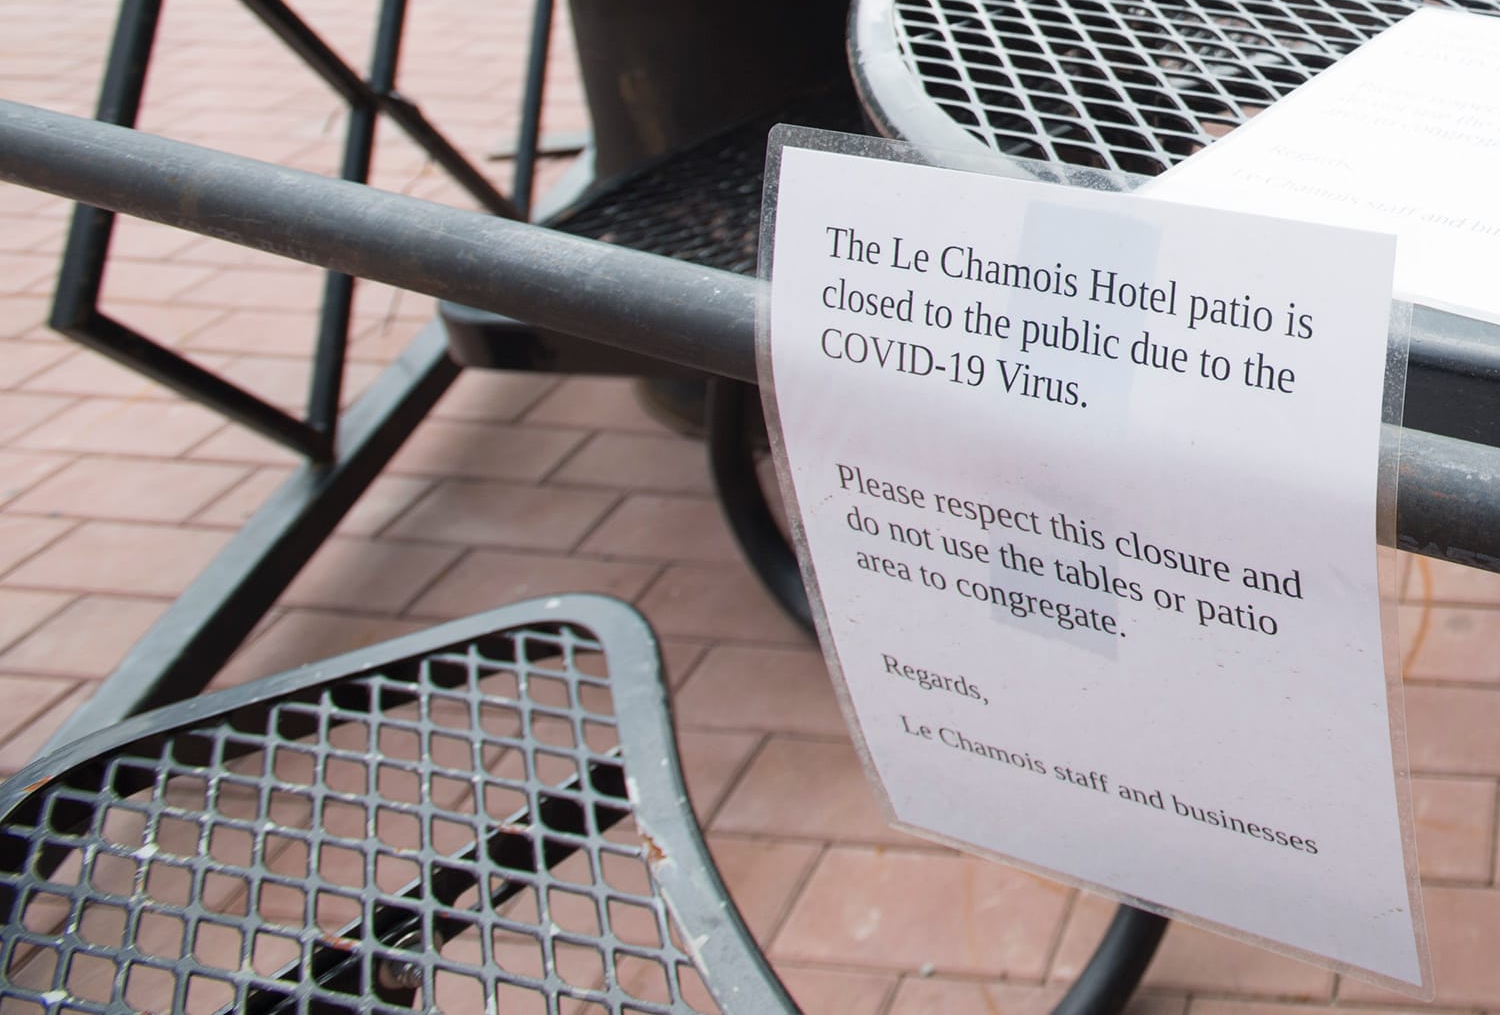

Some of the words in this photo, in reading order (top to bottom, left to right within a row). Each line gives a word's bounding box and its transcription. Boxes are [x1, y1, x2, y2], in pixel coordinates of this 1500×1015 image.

[822, 277, 914, 323] closed
[924, 298, 953, 329] to
[963, 300, 1011, 340] the
[1019, 315, 1120, 360] public
[1130, 330, 1189, 374] due
[1199, 348, 1231, 382] to
[1243, 352, 1296, 394] the
[825, 226, 881, 265] The
[890, 236, 930, 273] Le
[940, 245, 1078, 298] Chamois
[1088, 268, 1177, 316] Hotel
[1186, 294, 1273, 333] patio
[1283, 302, 1313, 340] is
[821, 328, 985, 387] COVID-19
[995, 358, 1088, 409] Virus.
[835, 463, 926, 509] Please
[933, 493, 1043, 536] respect
[1049, 512, 1106, 551] this
[1115, 530, 1231, 583] closure
[1242, 567, 1304, 600] and
[846, 505, 880, 536] do
[887, 522, 935, 551] not
[940, 535, 990, 564] use
[998, 542, 1045, 577] the
[1053, 558, 1144, 602] tables
[1153, 588, 1186, 614] or
[1195, 598, 1278, 636] patio
[856, 551, 913, 582] area
[918, 565, 947, 591] to
[955, 578, 1126, 638] congregate.
[881, 653, 989, 706] Regards,
[900, 715, 932, 740] Le
[938, 727, 1047, 775] Chamois
[1053, 765, 1108, 794] staff
[1118, 786, 1165, 810] and
[1171, 794, 1319, 855] businesses
